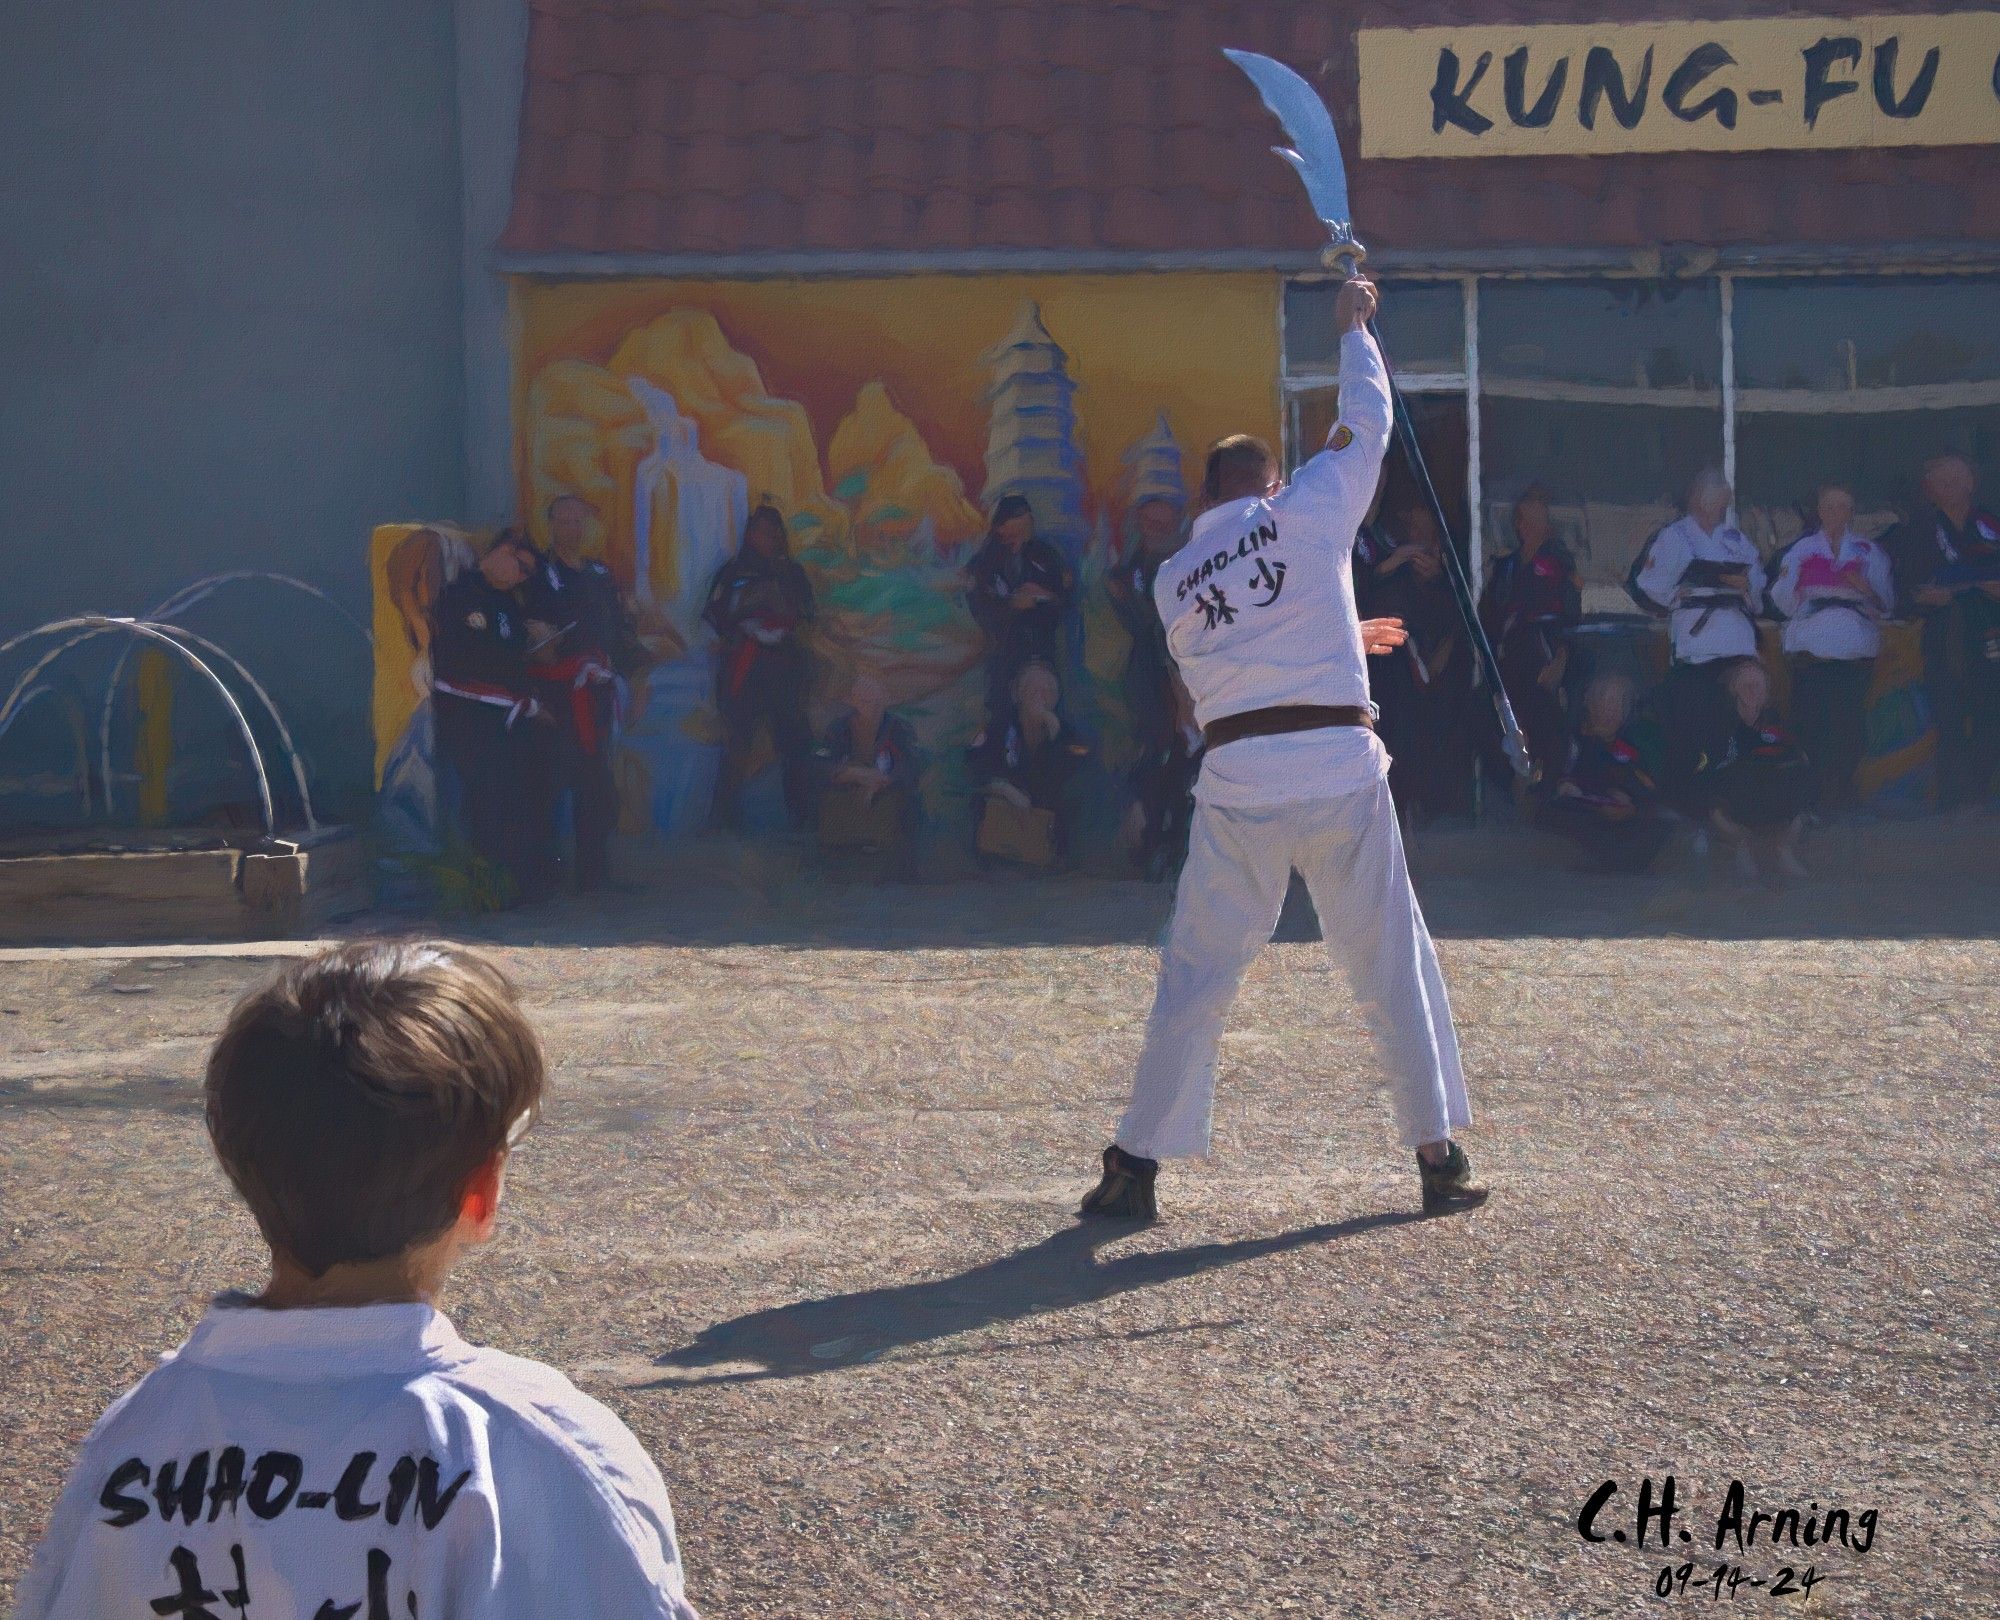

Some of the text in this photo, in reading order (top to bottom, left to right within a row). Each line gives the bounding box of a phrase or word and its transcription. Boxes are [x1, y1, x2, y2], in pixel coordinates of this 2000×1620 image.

[1430, 36, 1940, 137] KUNG-FU
[1176, 519, 1279, 602] SHAO-LIN
[98, 1445, 472, 1531] SHAO-LIN
